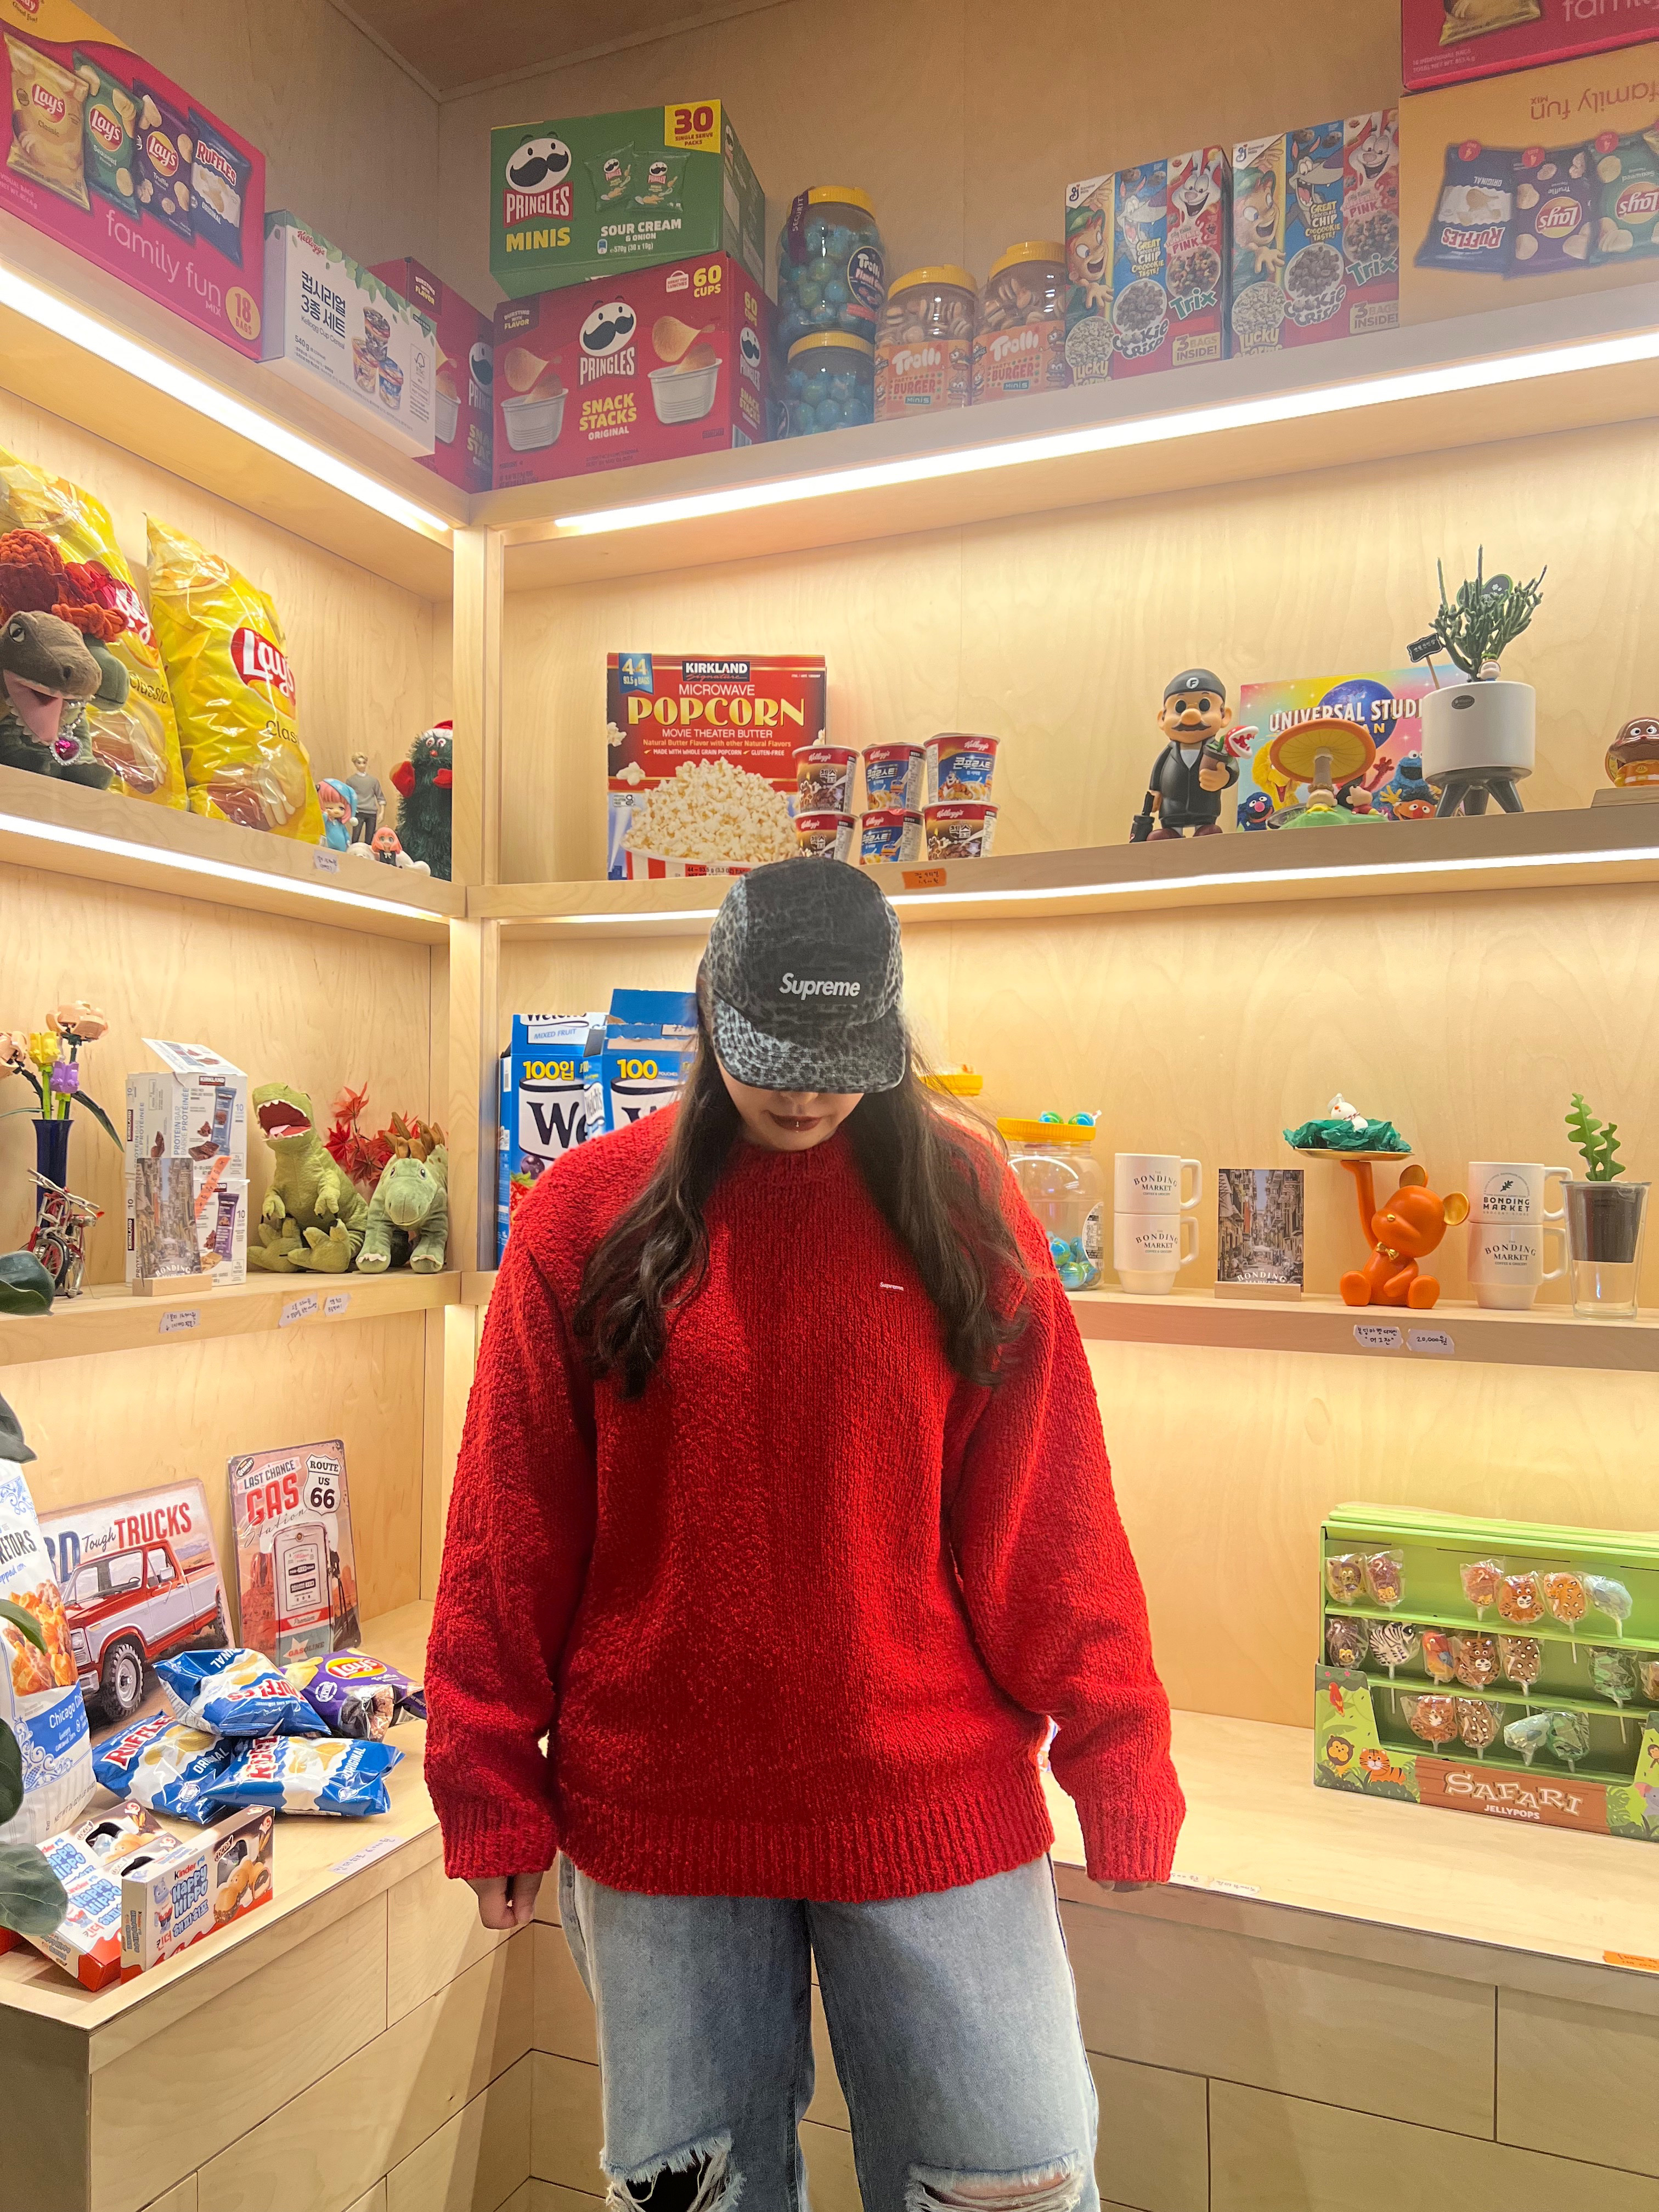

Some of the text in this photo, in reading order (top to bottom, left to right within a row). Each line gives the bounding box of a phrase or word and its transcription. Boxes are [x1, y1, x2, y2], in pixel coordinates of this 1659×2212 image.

[33, 83, 64, 114] Lay's
[1530, 95, 1549, 105] MIX
[1530, 99, 1571, 121] fun
[92, 110, 121, 141] Lay's
[674, 106, 714, 135] 30
[149, 140, 177, 170] Lay's
[197, 140, 236, 186] RUFFLES
[1474, 176, 1503, 188] ORIGINAL
[506, 185, 570, 224] PRINGLES
[1310, 201, 1337, 215] GREAT
[1350, 201, 1378, 218] PINK
[601, 218, 682, 237] SOUR CREAM
[1312, 215, 1337, 228] CHIP
[1537, 205, 1578, 233] Lay's
[297, 230, 325, 255] Kellogg's
[506, 227, 571, 253] MINIS
[632, 233, 657, 241] ONION
[1136, 238, 1161, 251] GREAT
[1441, 226, 1505, 250] RUFFLES
[1172, 238, 1199, 255] PINK
[105, 210, 222, 307] family fun
[1137, 252, 1161, 264] CHIP
[693, 265, 722, 287] 60
[1346, 253, 1398, 287] Trix
[301, 270, 346, 318] 컵시리얼
[693, 284, 721, 298] CUPS
[205, 300, 222, 317] MIX
[234, 292, 252, 323] 18
[1168, 287, 1218, 320] Trix
[1353, 302, 1368, 319] 3
[301, 294, 346, 339] 3종 세트
[504, 318, 530, 330] FLAVOR
[1353, 314, 1398, 329] INSIDE!
[235, 317, 252, 335] BAGS
[301, 315, 346, 350] Kellogg Cup Cereal
[295, 335, 306, 347] 540
[989, 330, 1040, 363] Trolli
[1176, 334, 1218, 351] 3 BAGS
[891, 347, 941, 375] Trolli
[1176, 346, 1217, 361] INSIDE!
[579, 346, 635, 385] PRINGLES
[991, 361, 1034, 379] BURGER
[893, 379, 936, 395] BURGER
[582, 393, 635, 416] SNACK
[579, 407, 637, 432] STACKS
[588, 427, 630, 441] ORIGINAL
[242, 627, 296, 697] Lay's
[622, 658, 648, 675] 44
[685, 662, 748, 674] KIRKLAND
[623, 676, 634, 685] 93.5
[1188, 679, 1197, 688] F
[679, 684, 755, 696] MICROWAVE
[627, 696, 805, 727] POPCORN
[662, 729, 773, 738] MOVIE THEATER BUTTER
[964, 740, 989, 751] Kellogg's
[952, 756, 992, 771] 콘푸로스트
[936, 809, 964, 819] Kellogg's
[778, 972, 861, 1001] Supreme
[533, 1028, 577, 1041] MIXED FRUIT
[522, 1060, 575, 1081] 100입
[617, 1059, 658, 1080] 100
[181, 1088, 189, 1131] PROTÉINÉE
[235, 1104, 244, 1112] 10
[1133, 1175, 1178, 1187] BONDING
[127, 1198, 133, 1209] 10
[1483, 1197, 1530, 1206] BONDING
[1483, 1203, 1530, 1212] MARKET
[236, 1210, 246, 1219] 10
[1135, 1233, 1178, 1245] BONDING
[1484, 1243, 1537, 1257] BONDING
[1493, 1253, 1530, 1261] MARKET
[155, 1263, 191, 1278] BONDING
[1237, 1271, 1287, 1284] BONDING
[879, 1281, 905, 1291] Supreme
[1416, 1335, 1448, 1346] 20,000원
[244, 1459, 296, 1490] LAST CHANCE
[309, 1460, 339, 1472] ROUTE
[318, 1476, 330, 1486] US
[246, 1472, 299, 1527] GAS
[310, 1487, 335, 1509] 66
[82, 1502, 192, 1553] Tough TRUCKS
[244, 1508, 309, 1549] Station
[294, 1615, 315, 1625] Premium
[288, 1641, 325, 1657] GASOLINE
[330, 1658, 379, 1678] Lay's
[49, 1704, 76, 1729] Chicago
[193, 1748, 230, 1774] ORIGINAL
[343, 1747, 366, 1779] ORIGINAL
[1443, 1769, 1584, 1816] SAFARI
[1483, 1803, 1541, 1820] JELLYPOPS
[77, 1820, 95, 1840] COCOA
[214, 1834, 234, 1862] COCOA
[174, 1861, 198, 1881] Kinder
[172, 1899, 209, 1938] 해피히포
[82, 1923, 105, 1939] 킨더
[156, 1931, 172, 1953] 킨더
